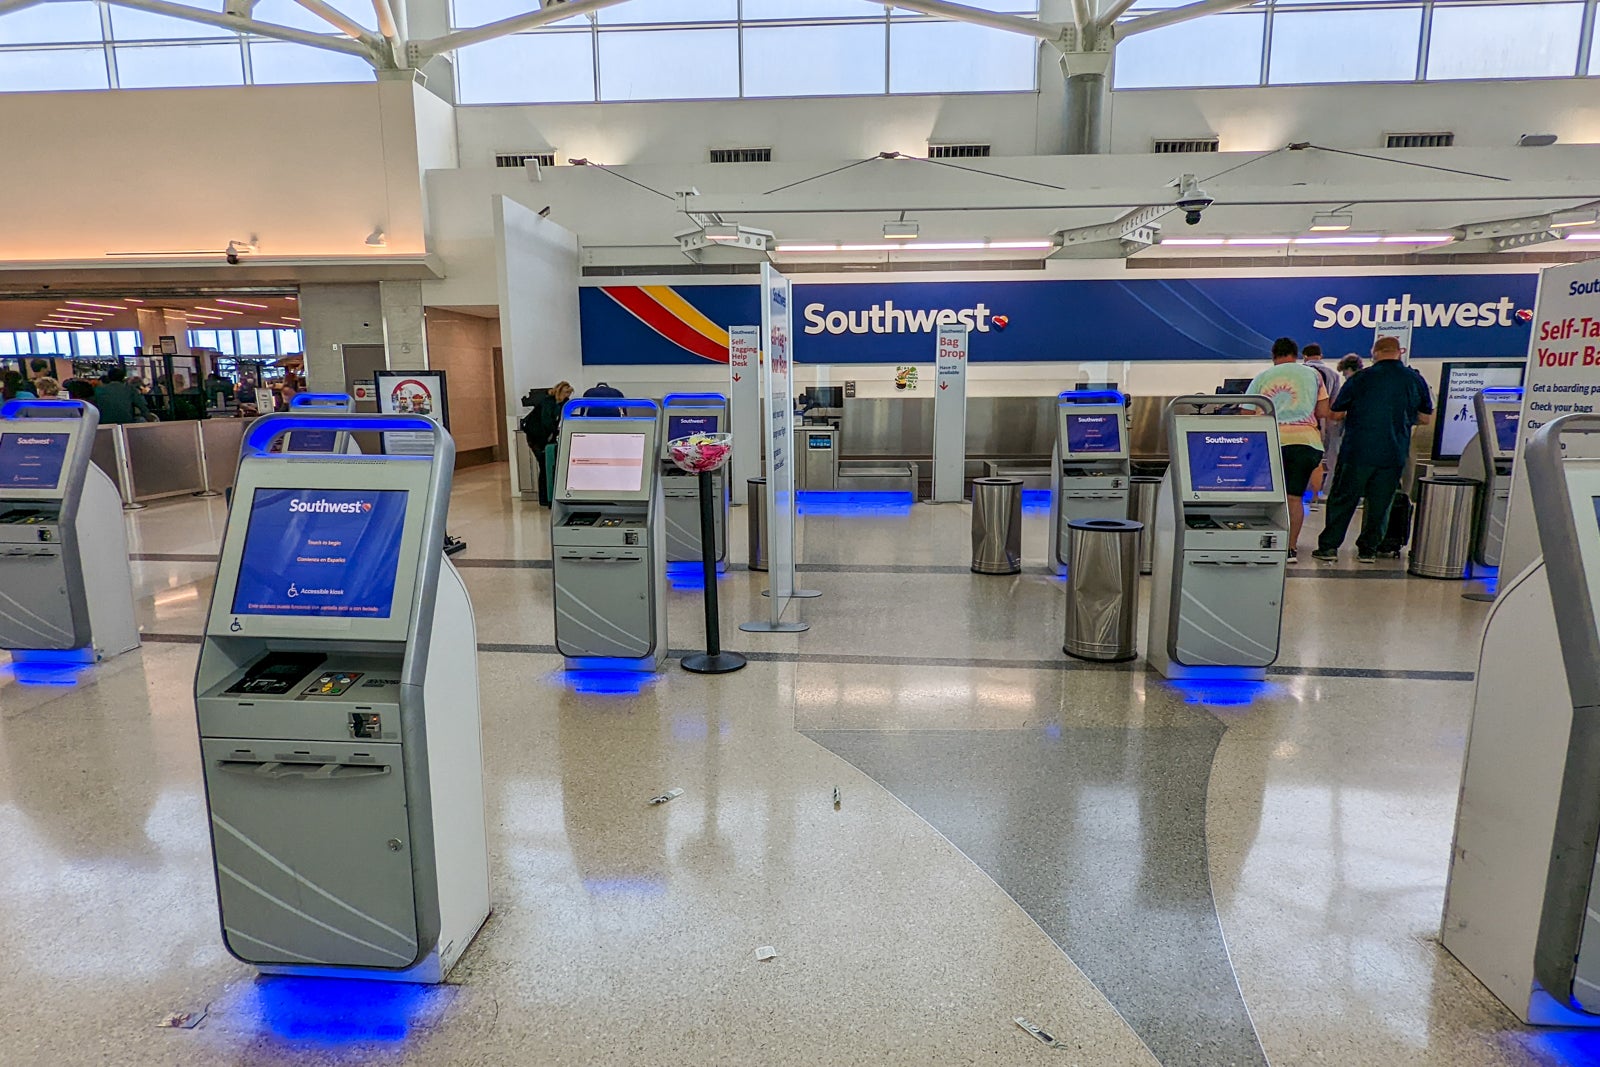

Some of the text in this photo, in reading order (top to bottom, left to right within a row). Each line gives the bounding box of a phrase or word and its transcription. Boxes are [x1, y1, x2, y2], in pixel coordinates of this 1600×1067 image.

[1568, 278, 1600, 296] Sout
[803, 300, 990, 335] Southwest
[1313, 293, 1515, 329] Southwest
[1540, 317, 1600, 341] Self-Ta
[940, 337, 959, 348] Bag
[940, 349, 965, 360] Drop
[1537, 347, 1579, 367] Your
[1532, 383, 1545, 392] Get
[1553, 383, 1589, 396] boarding
[1530, 401, 1593, 413] Check your bags
[1205, 436, 1244, 444] Southwest
[289, 498, 362, 513] Southwest
